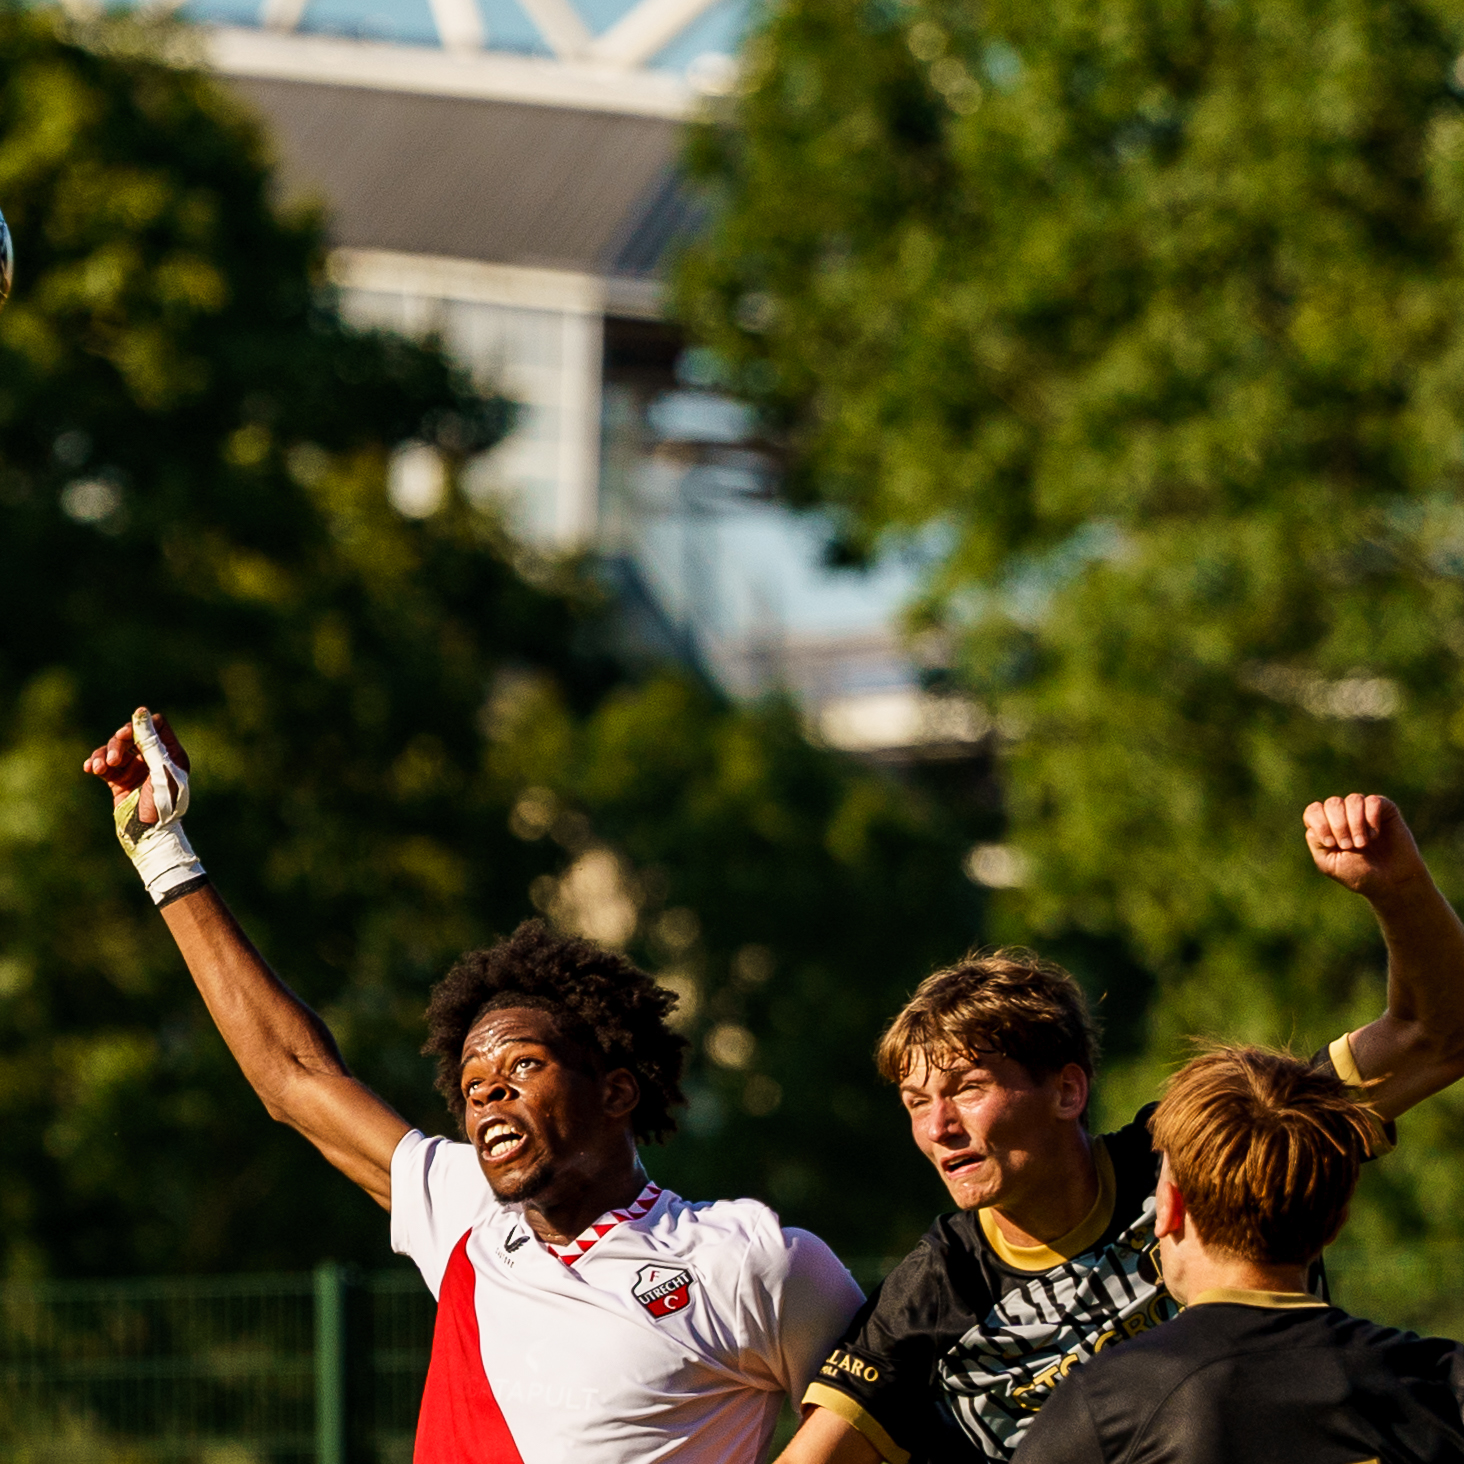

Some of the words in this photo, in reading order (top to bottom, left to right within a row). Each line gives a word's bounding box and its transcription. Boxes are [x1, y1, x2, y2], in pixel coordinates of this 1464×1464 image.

[649, 1270, 660, 1282] F
[638, 1272, 690, 1305] UTRECHT
[663, 1295, 679, 1310] C
